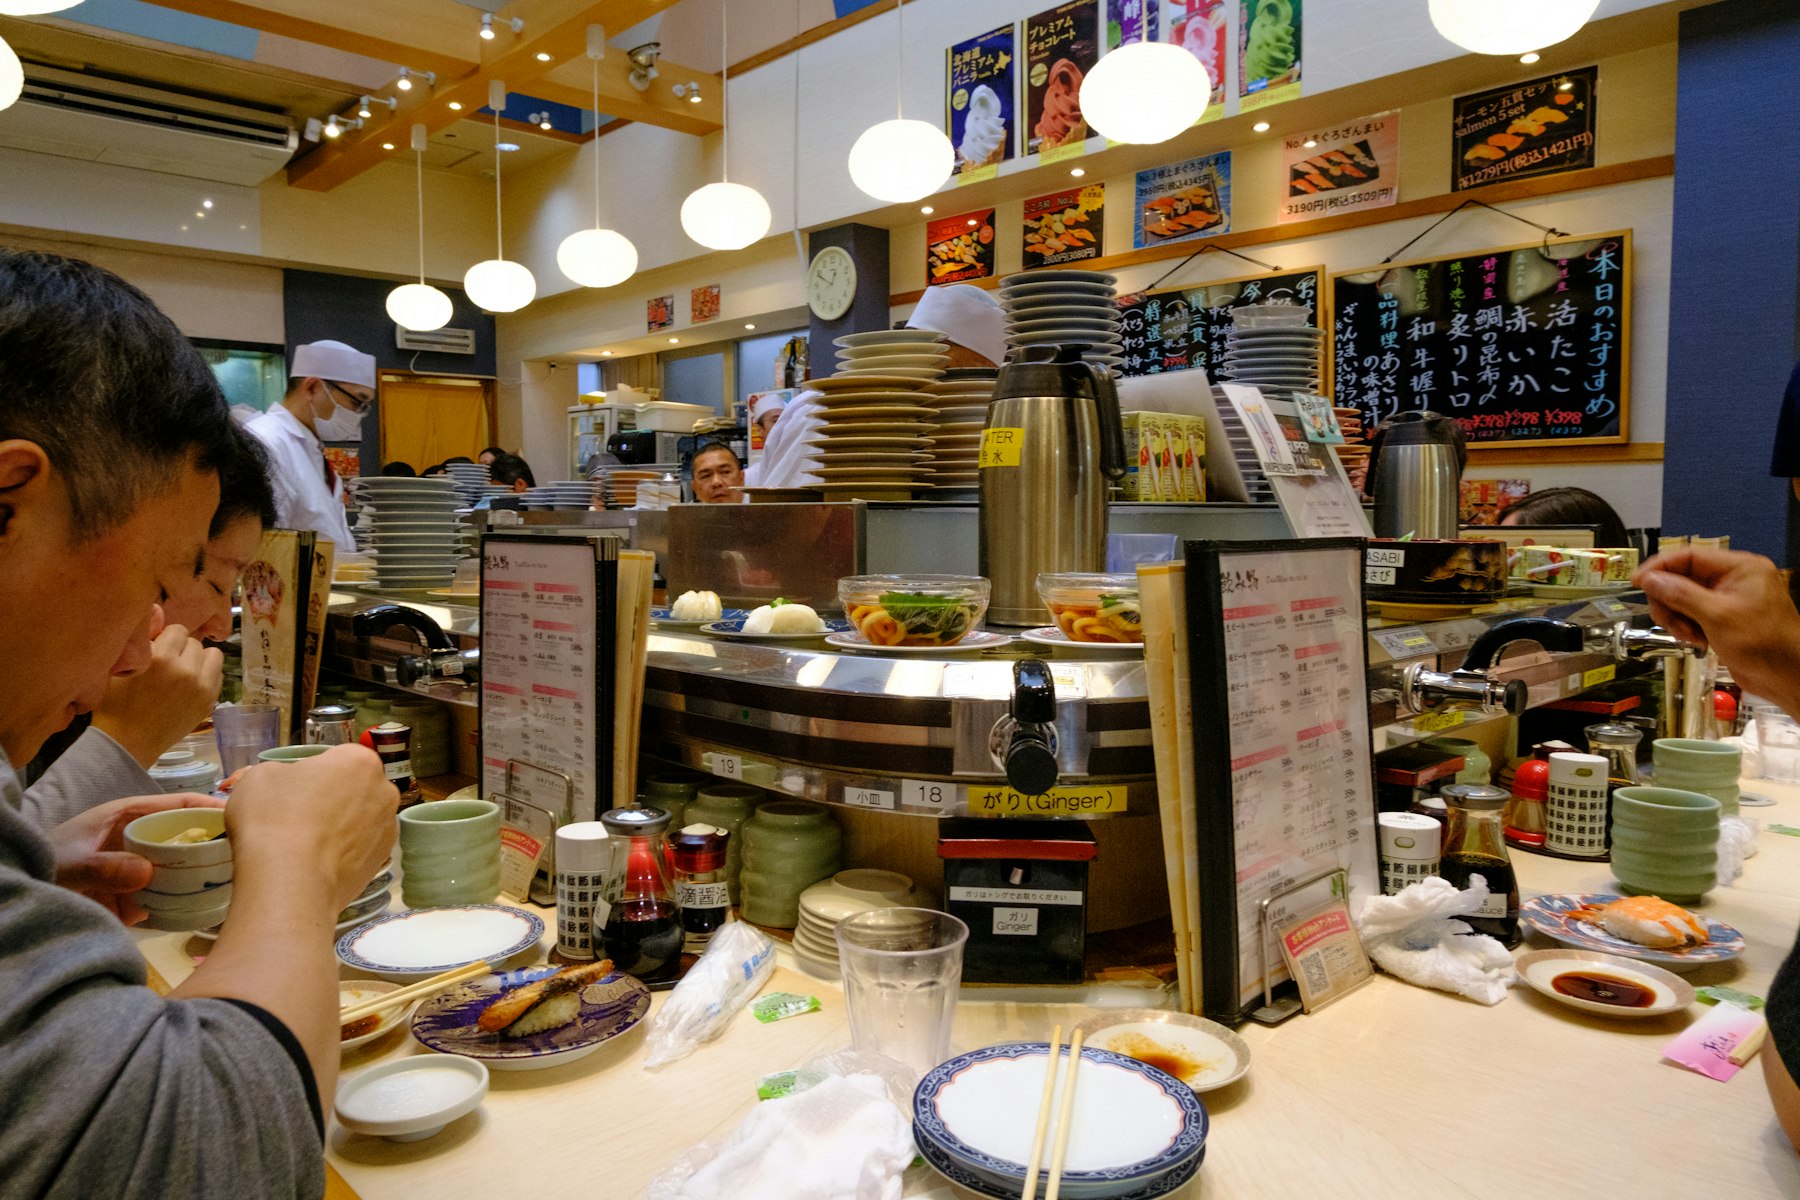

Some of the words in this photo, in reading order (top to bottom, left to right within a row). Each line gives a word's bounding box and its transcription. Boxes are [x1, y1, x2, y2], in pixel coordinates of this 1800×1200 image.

[1029, 16, 1074, 40] プレミアム
[1029, 29, 1077, 52] チョコレート
[953, 46, 981, 67] 北海道
[953, 54, 995, 78] プレミアム
[953, 72, 978, 88] バニラ
[1455, 114, 1497, 138] salmon
[1499, 107, 1506, 121] 5
[1508, 103, 1526, 117] set
[1287, 187, 1393, 215] 3190円(税込3509円)
[1119, 317, 1143, 334] 大とろ
[1584, 248, 1620, 419] 本日のおすすめ
[1122, 336, 1145, 351] 中とろ
[1504, 305, 1540, 394] 赤いか
[1544, 299, 1578, 392] 活たこ
[1406, 316, 1437, 412] 和牛握り
[1380, 350, 1401, 418] あさり
[1545, 408, 1584, 426] ¥398
[1366, 550, 1400, 563] ASABI
[720, 758, 734, 774] 19
[856, 790, 881, 806] 小皿
[919, 786, 942, 802] 18
[677, 886, 727, 906] 滴醤油
[965, 890, 1068, 901] ガリはトングでお取りください
[996, 922, 1033, 932] Ginger
[1009, 912, 1029, 922] ガリ
